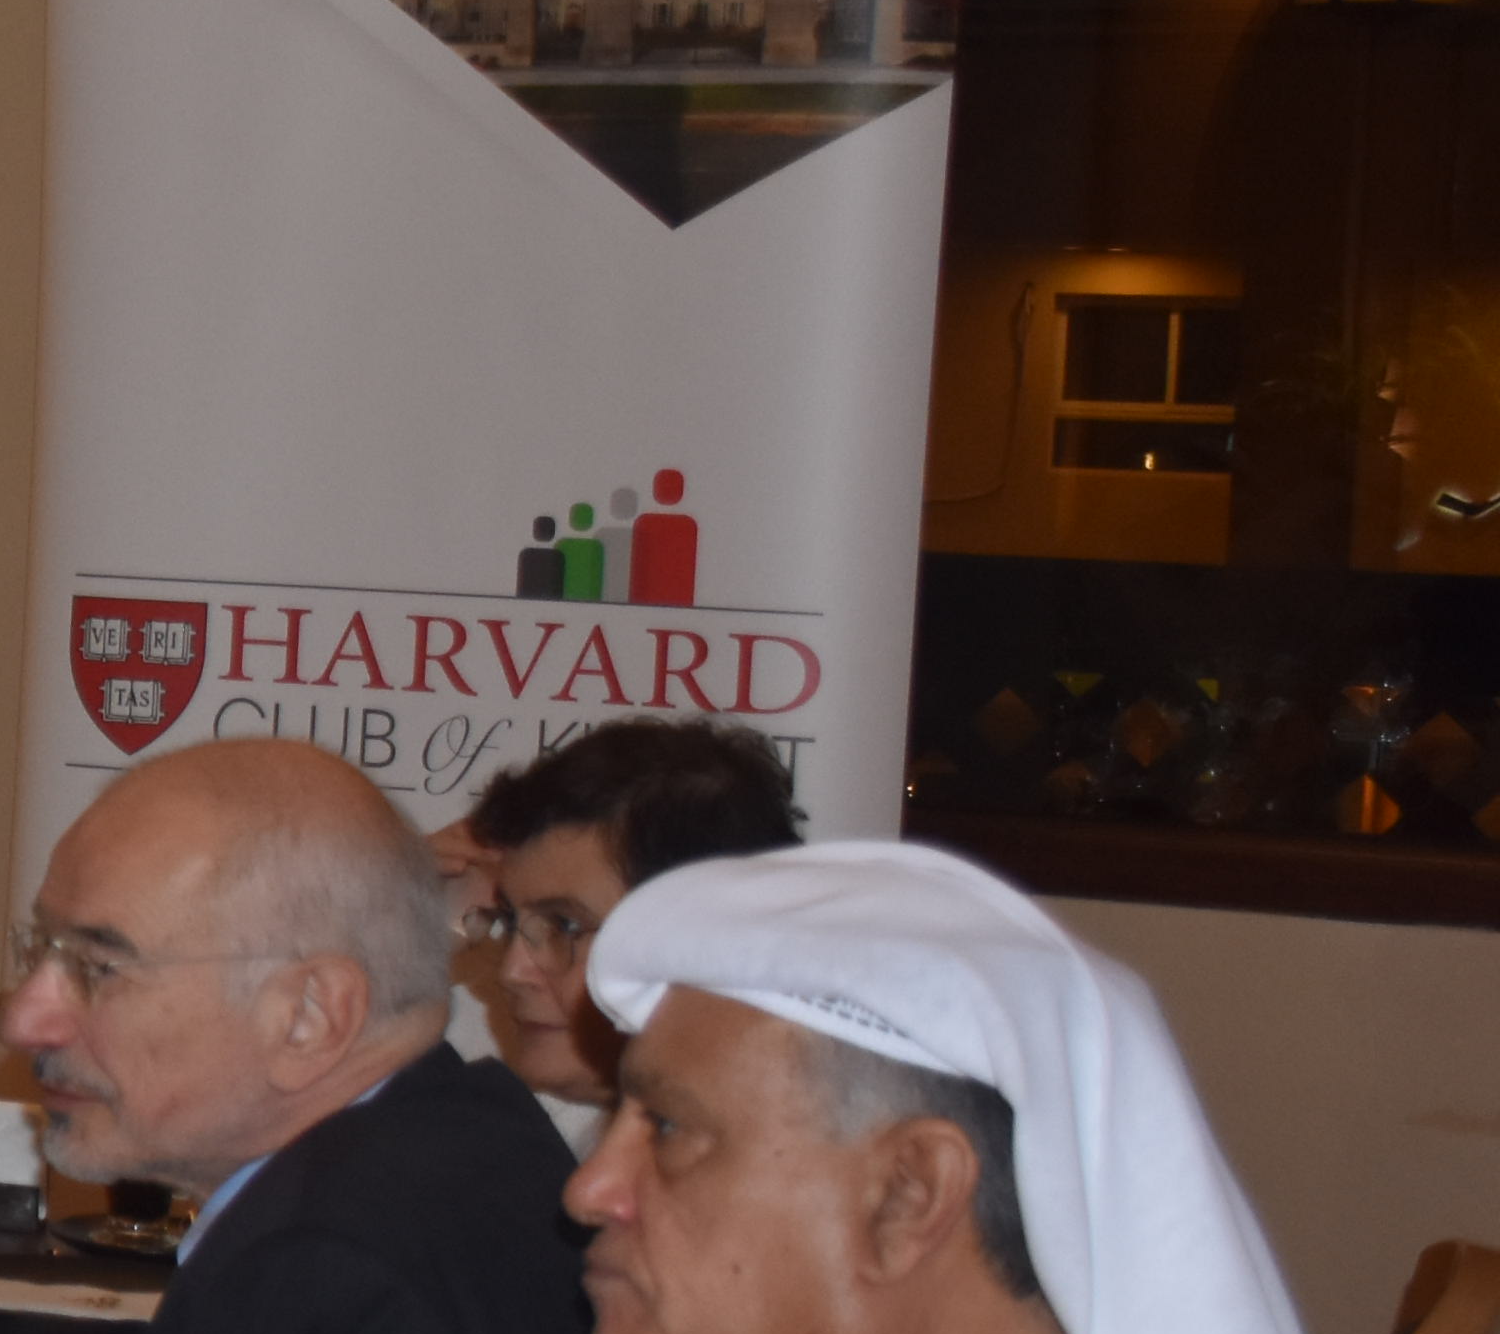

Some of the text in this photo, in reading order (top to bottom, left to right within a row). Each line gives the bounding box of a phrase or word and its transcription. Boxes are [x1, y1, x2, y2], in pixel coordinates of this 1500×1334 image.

[91, 627, 177, 649] VE RI
[217, 604, 822, 715] HARVARD
[114, 687, 150, 708] TAS
